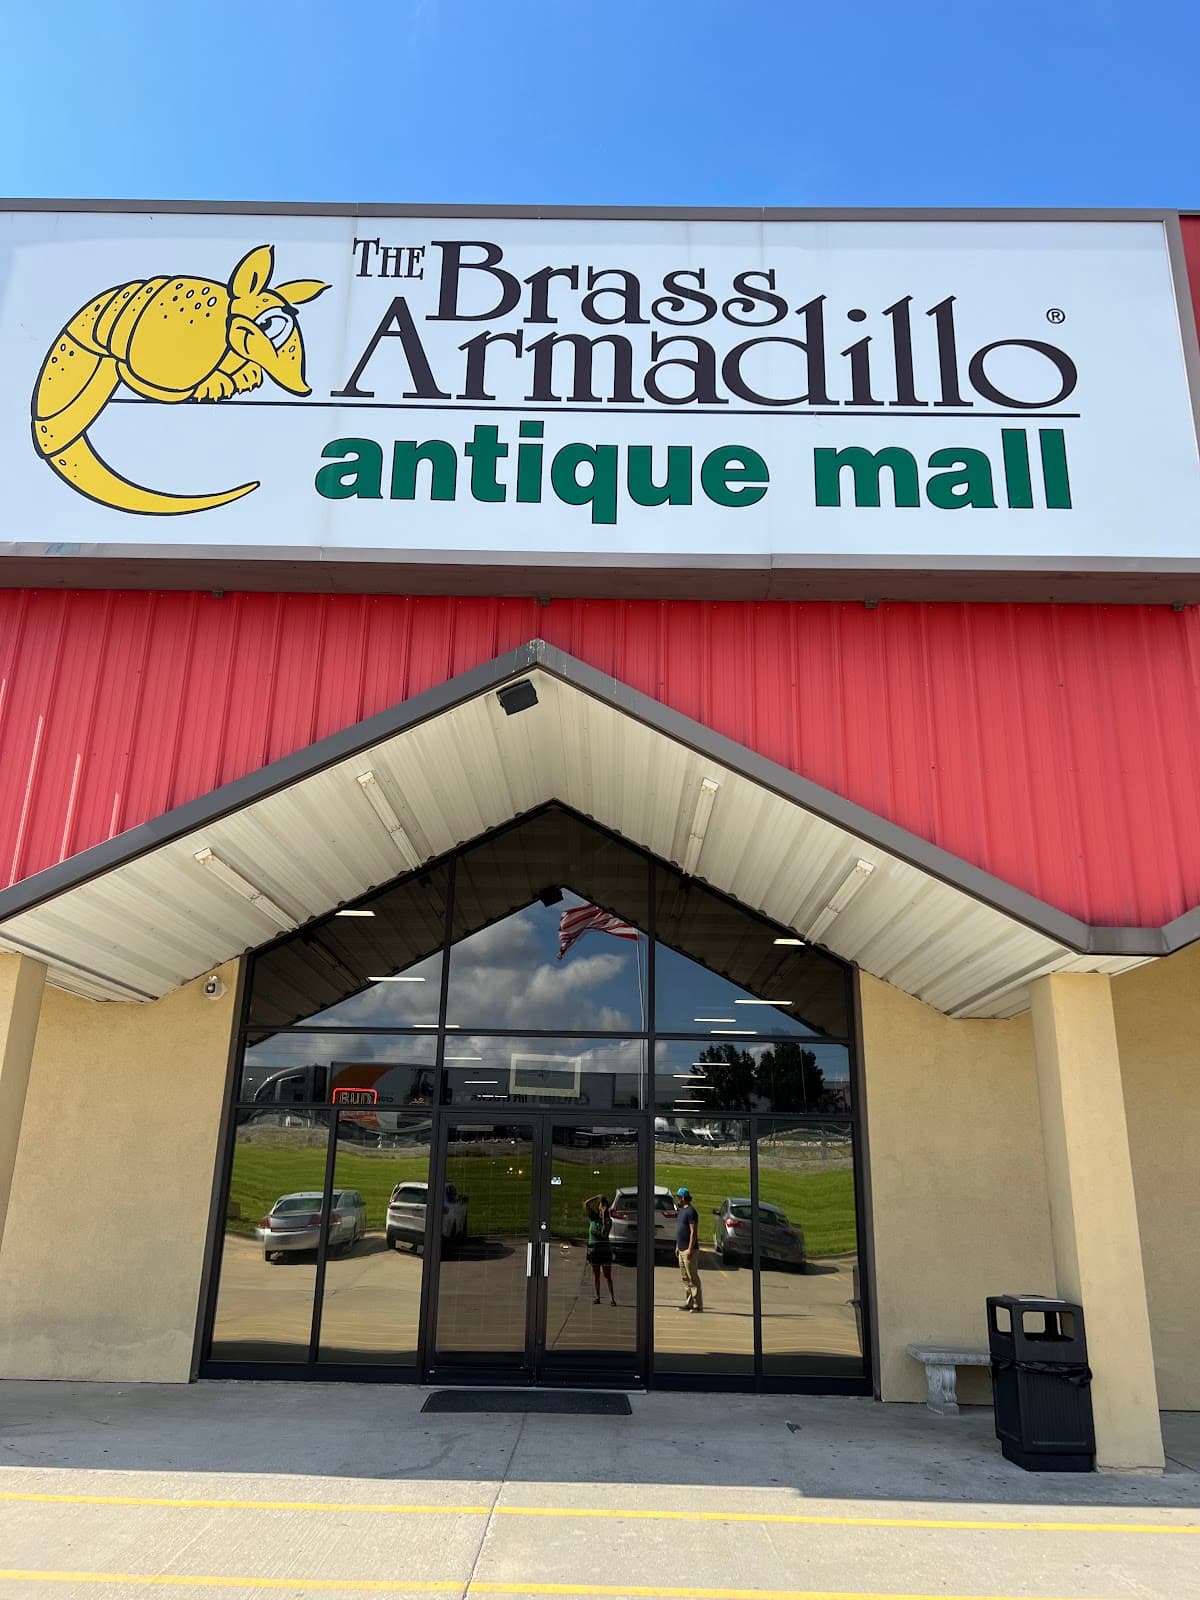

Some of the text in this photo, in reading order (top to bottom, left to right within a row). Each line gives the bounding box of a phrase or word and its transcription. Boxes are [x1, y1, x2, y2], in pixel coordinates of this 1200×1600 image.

[353, 238, 789, 327] THE Brass
[330, 295, 1078, 409] Armadillo
[315, 420, 1073, 525] antique mall
